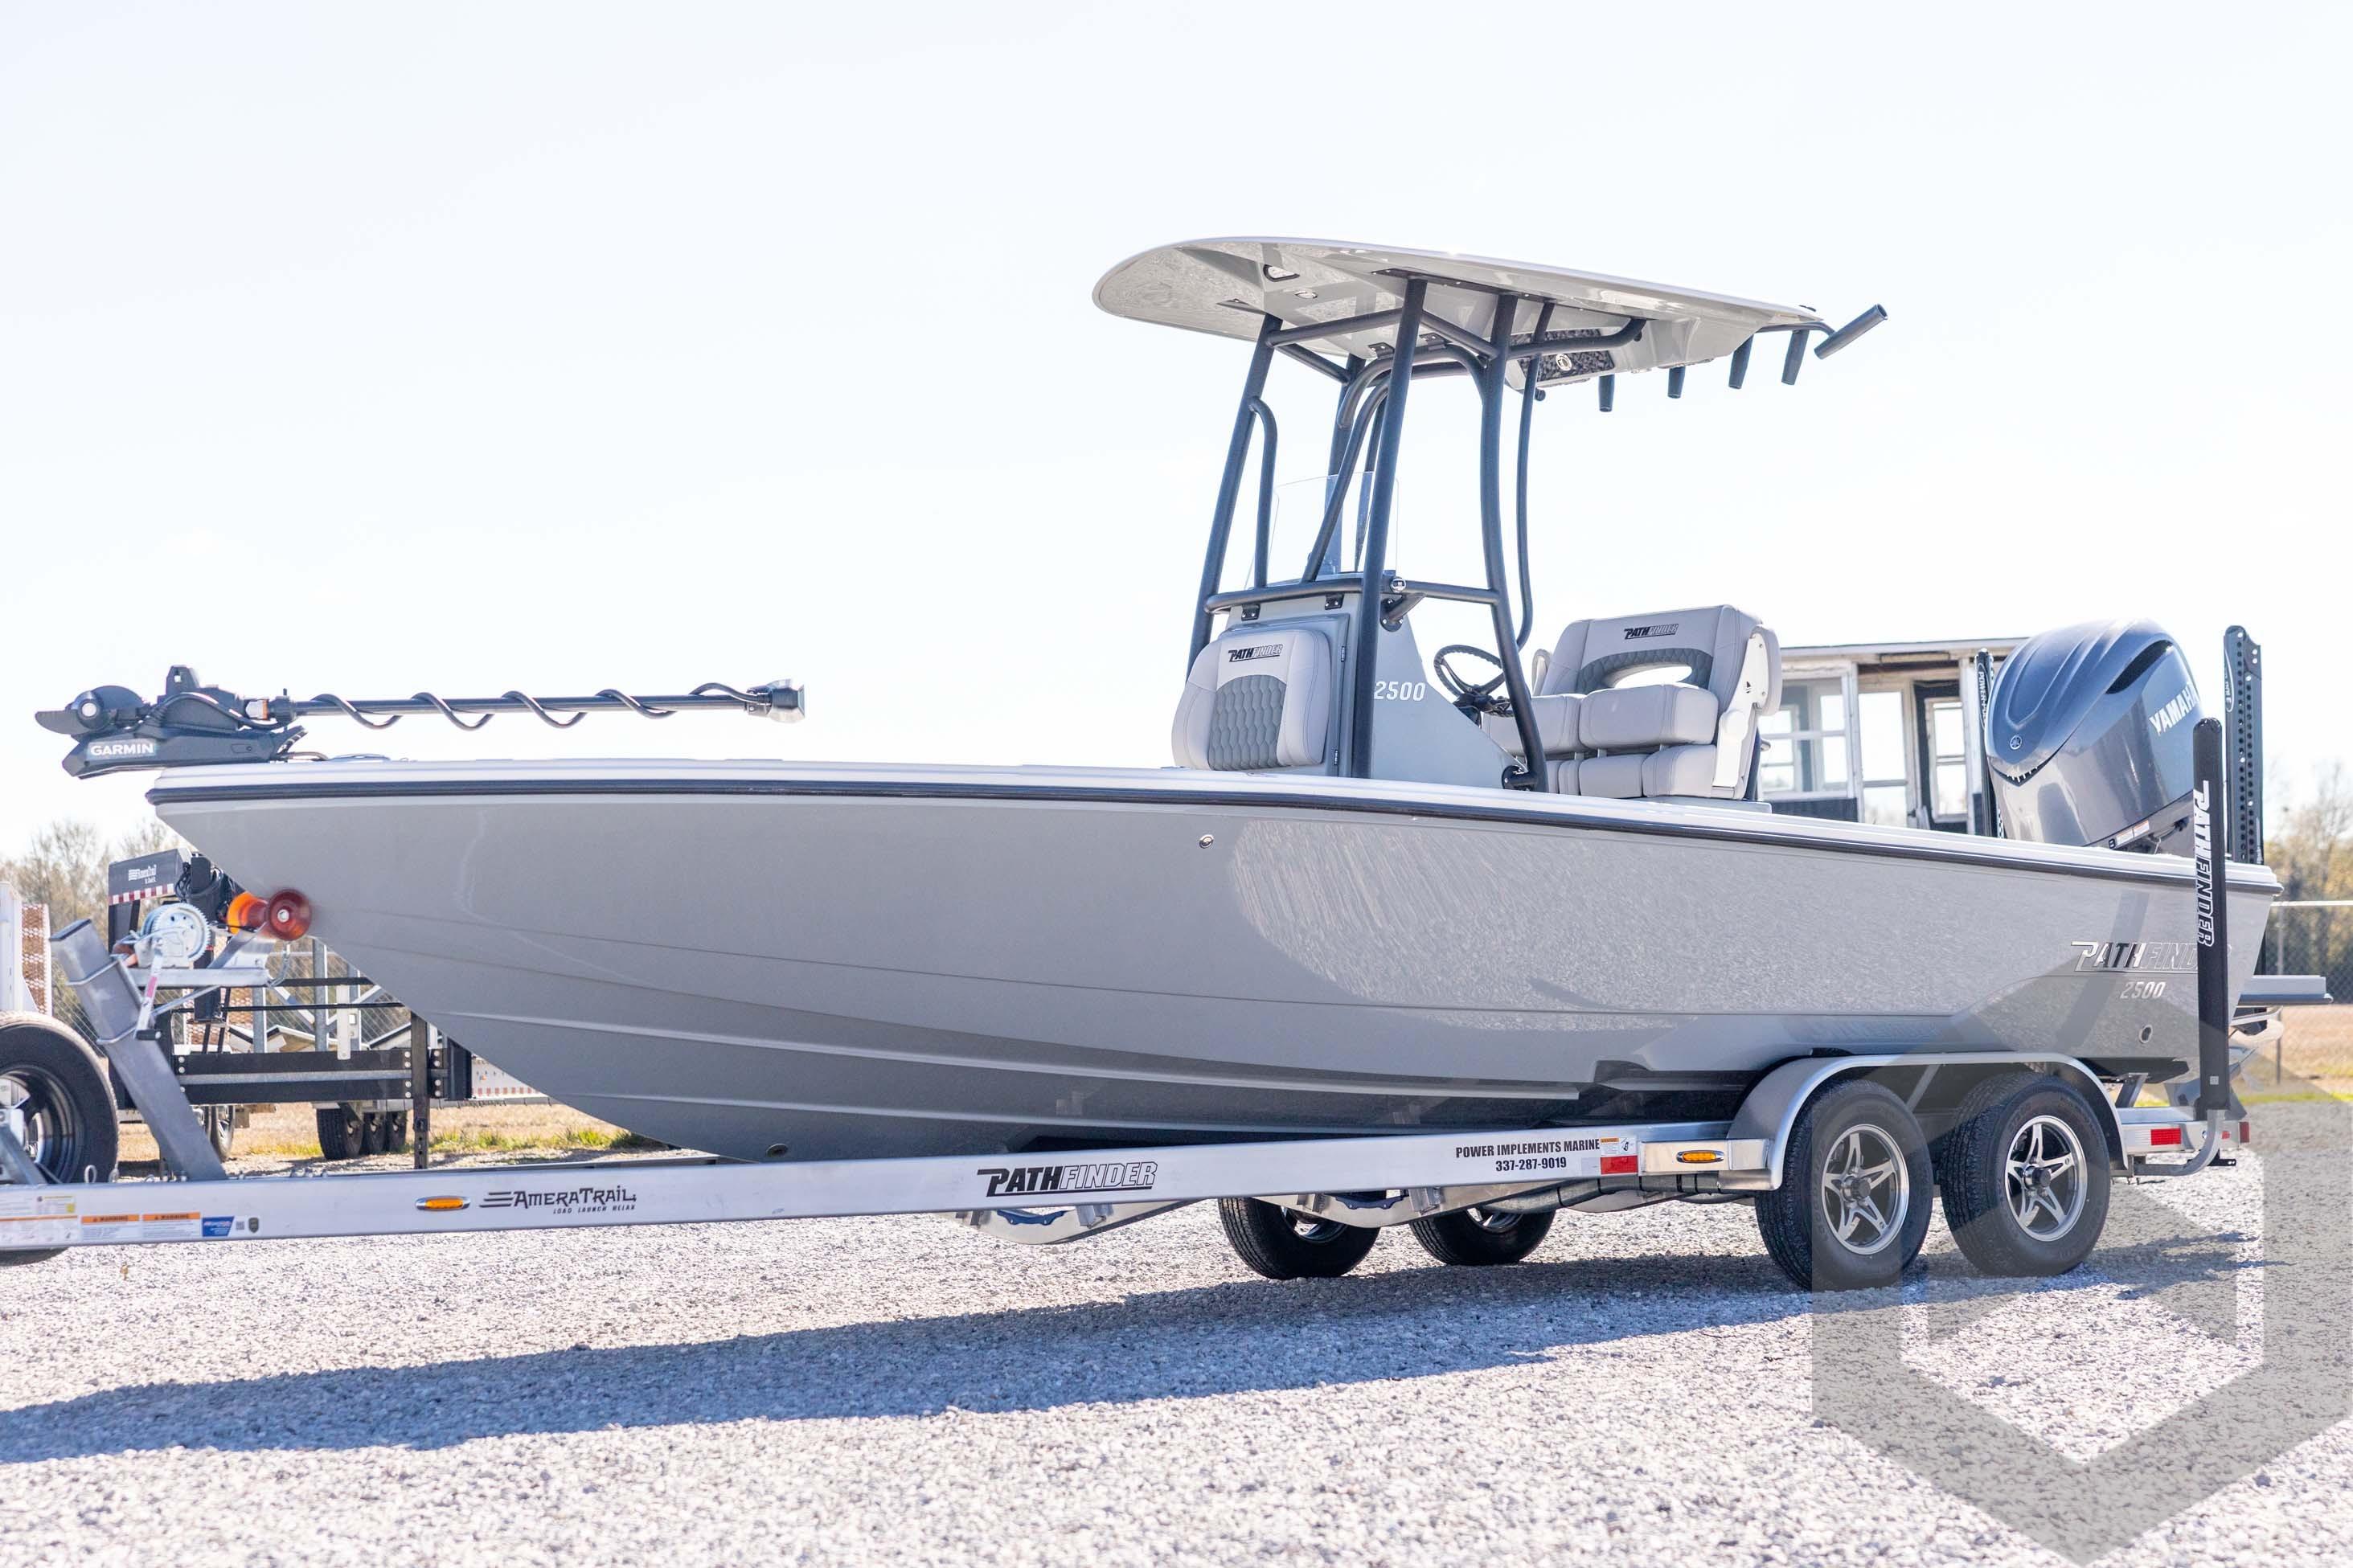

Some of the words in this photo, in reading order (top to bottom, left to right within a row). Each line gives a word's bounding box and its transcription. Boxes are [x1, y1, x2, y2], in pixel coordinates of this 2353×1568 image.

[1624, 624, 1679, 640] PATHFINDER
[1228, 644, 1283, 662] PATHFINDER
[1374, 682, 1425, 701] 2500
[90, 743, 154, 755] GARMIN
[2120, 981, 2166, 999] 2500
[1456, 1145, 1494, 1158] POWER
[1497, 1140, 1561, 1156] IMPLEMENTS
[1564, 1139, 1600, 1152] MARINE
[1495, 1157, 1567, 1172] 337-287-9019
[977, 1161, 1158, 1197] PATHFINDER
